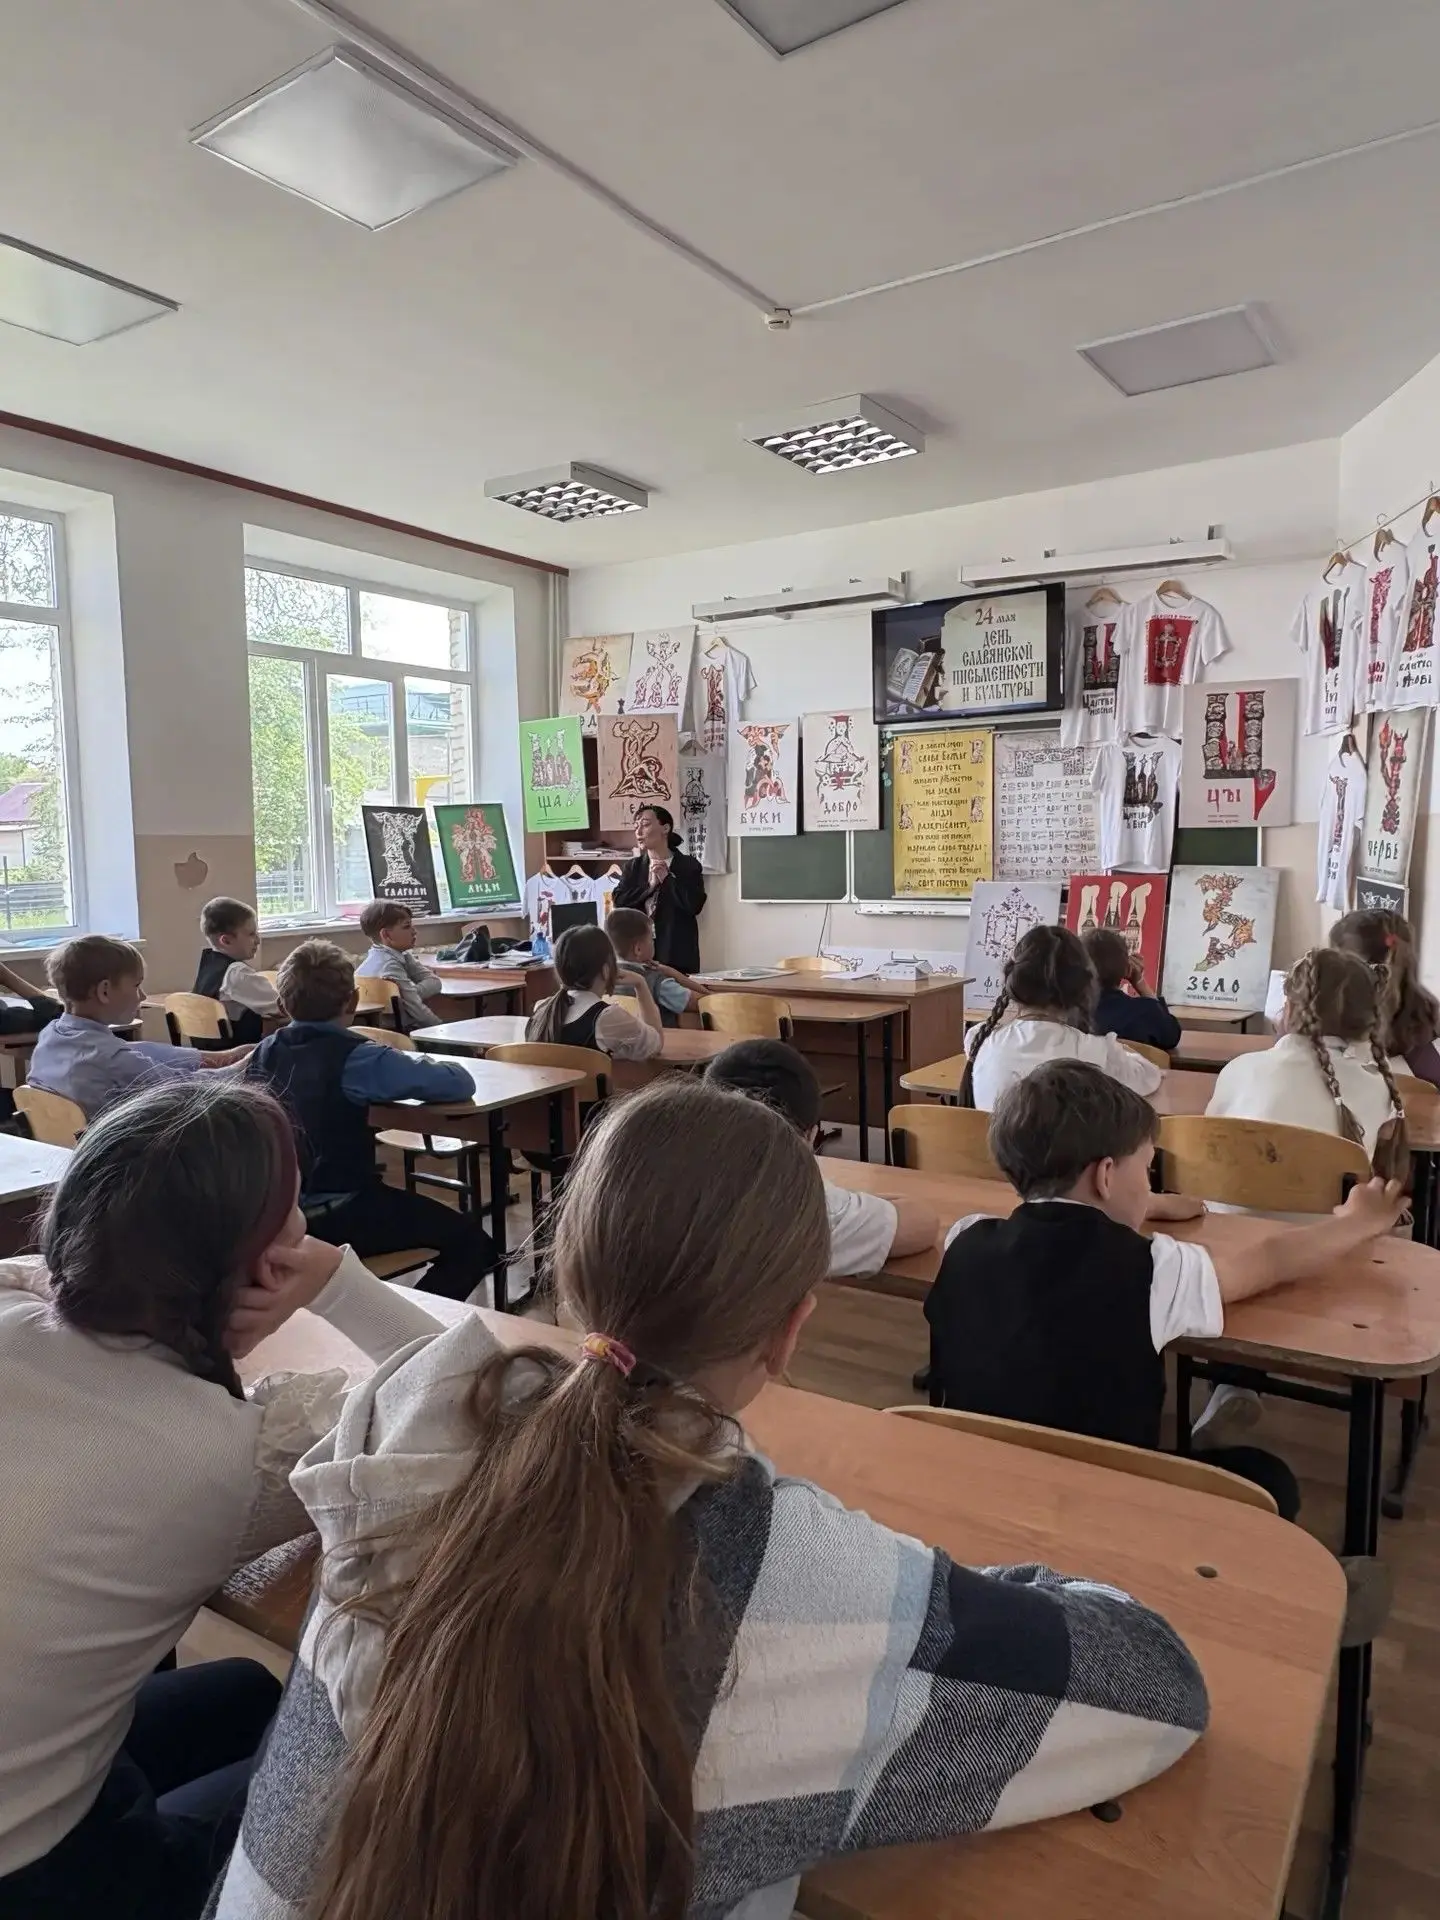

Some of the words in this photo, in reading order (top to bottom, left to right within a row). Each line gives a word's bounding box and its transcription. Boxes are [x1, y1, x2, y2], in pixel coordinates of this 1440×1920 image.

[975, 606, 993, 626] 24
[983, 629, 1012, 649] ДЕНЬ
[962, 641, 1034, 666] СЛАВЯНСКОЙ
[952, 661, 1044, 685] ПИСЬМЕННОСТИ
[962, 687, 970, 703] И
[975, 681, 1034, 704] КУЛЬТУРЫ
[740, 811, 782, 824] БУКИ
[824, 801, 858, 818] ДОБРО
[1186, 975, 1241, 994] ЗЕЛО
